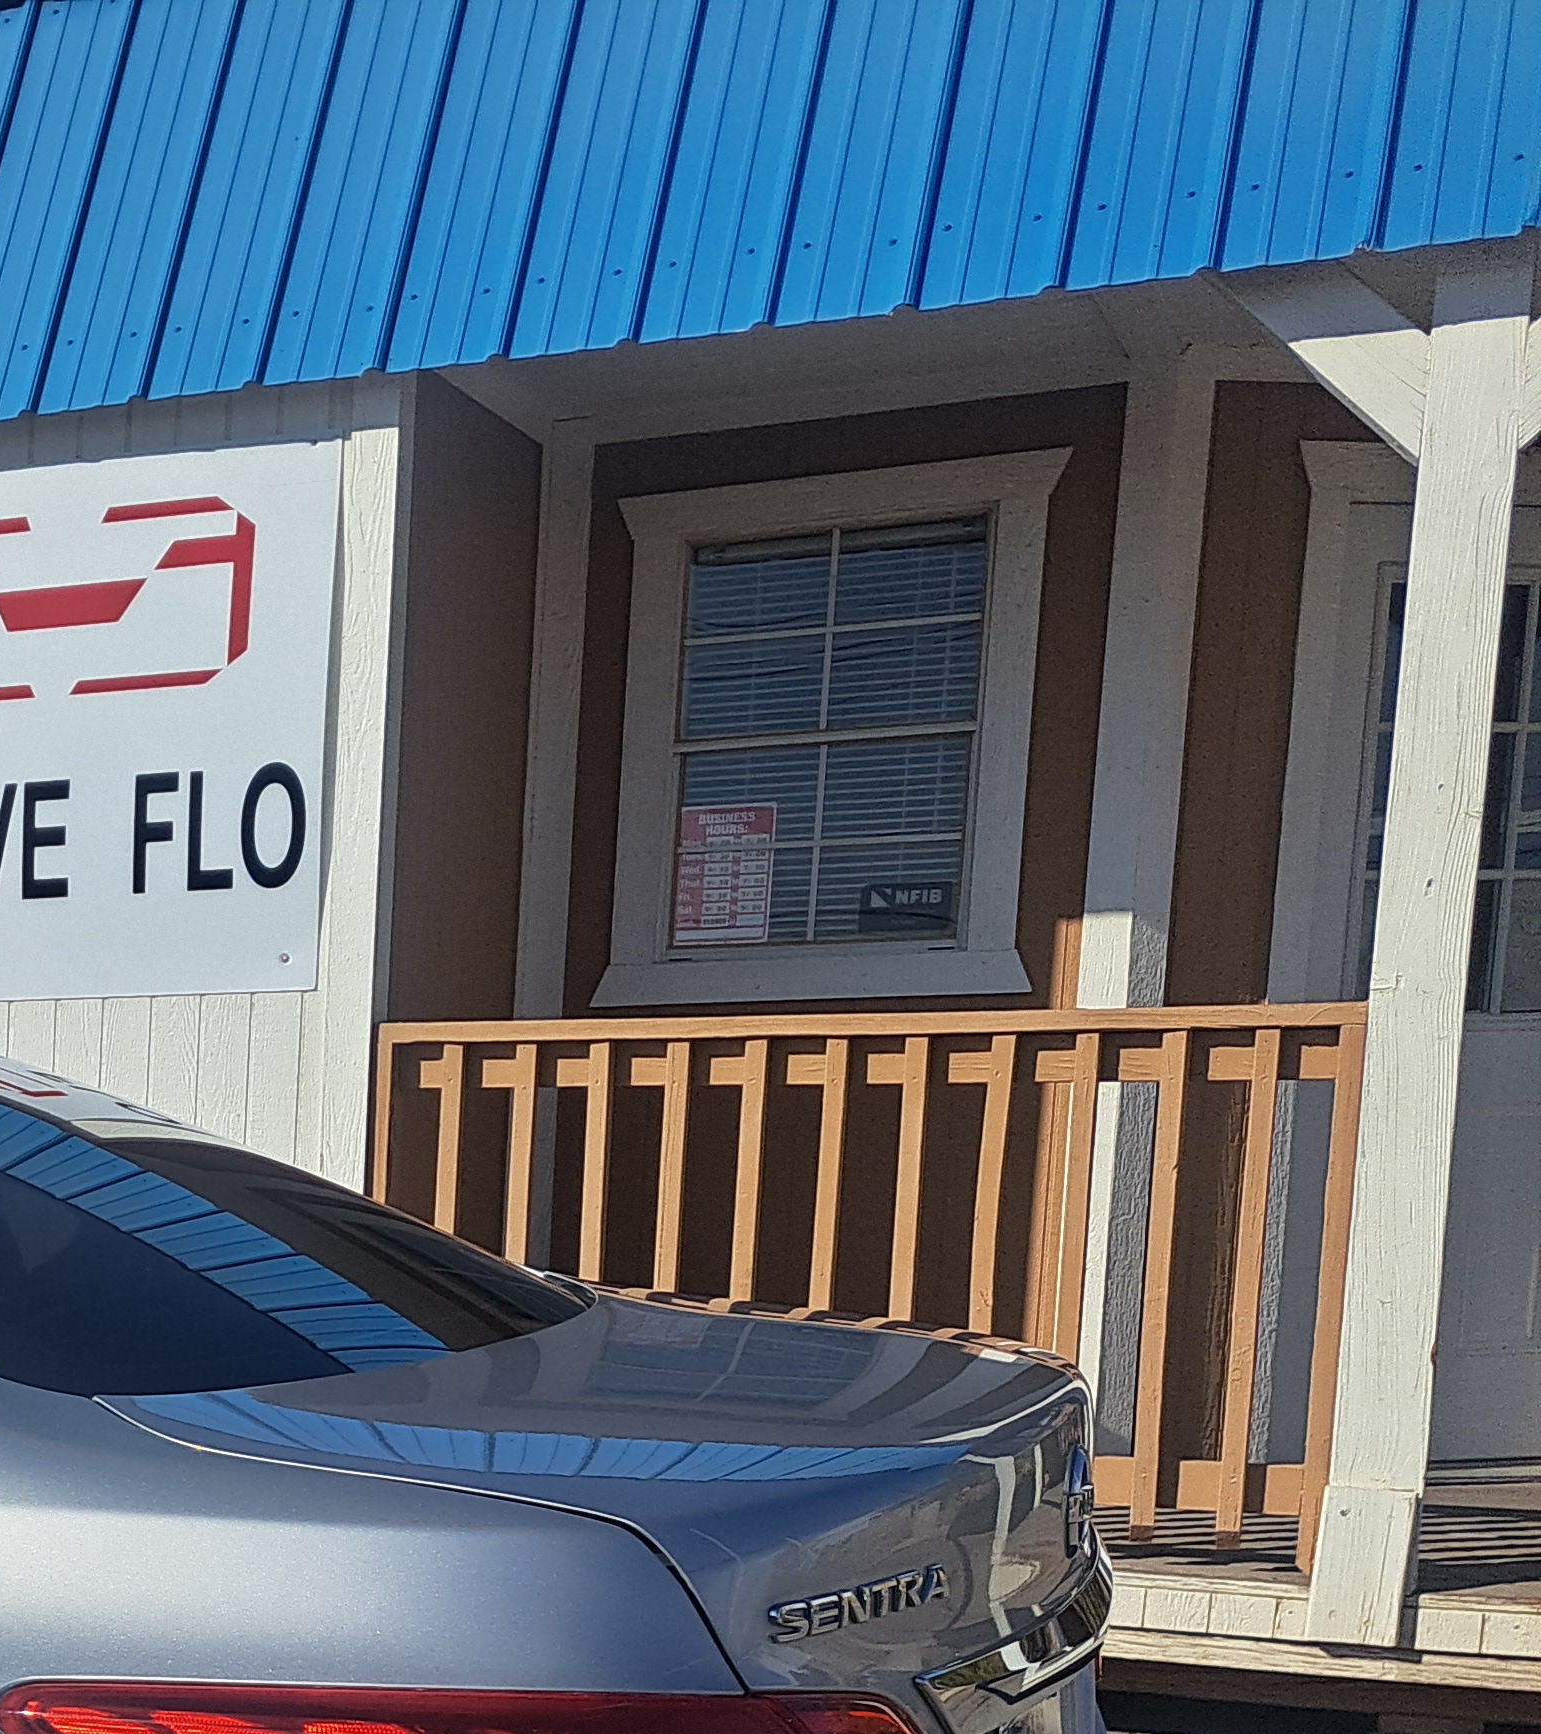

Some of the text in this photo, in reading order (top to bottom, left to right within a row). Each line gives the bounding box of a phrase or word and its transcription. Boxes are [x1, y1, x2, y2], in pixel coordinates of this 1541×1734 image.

[132, 761, 307, 895] FLO
[698, 811, 756, 825] BUSINESS
[895, 888, 943, 904] NFIB
[768, 1562, 951, 1643] SENTRA
